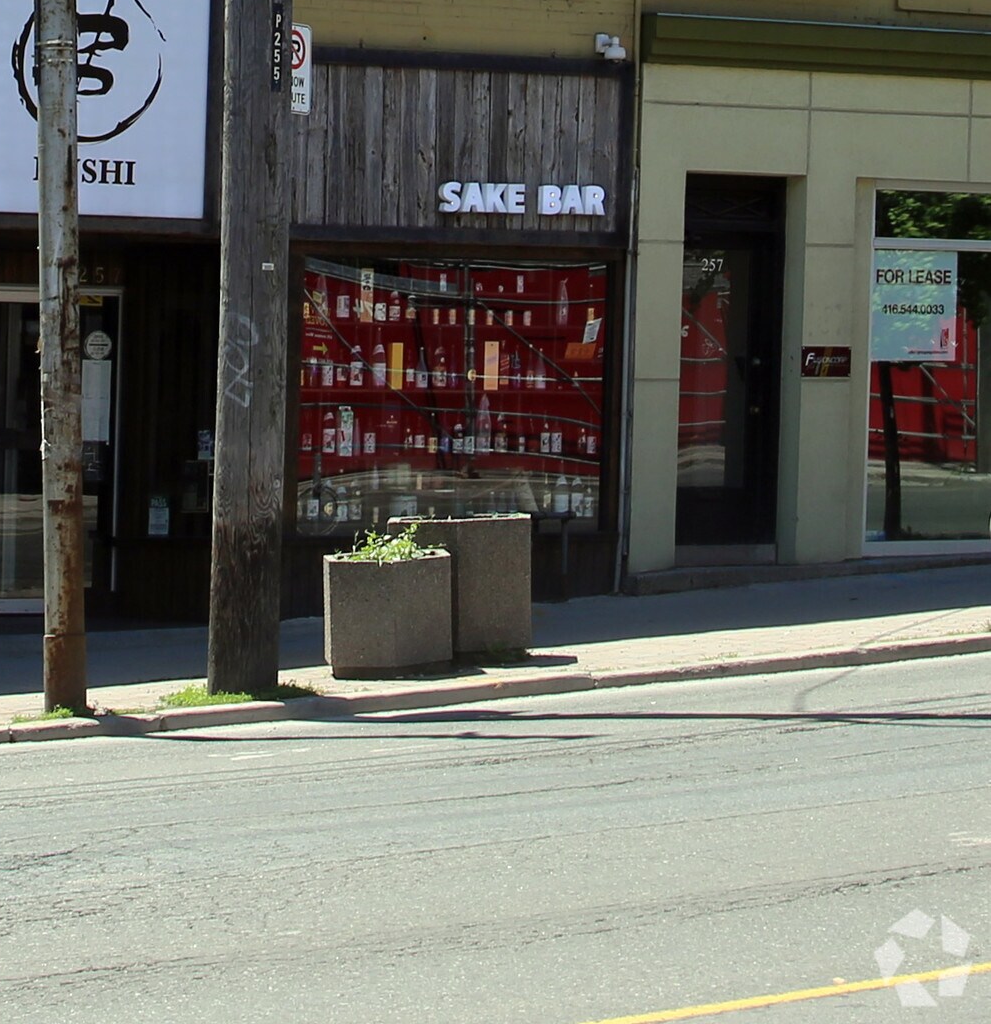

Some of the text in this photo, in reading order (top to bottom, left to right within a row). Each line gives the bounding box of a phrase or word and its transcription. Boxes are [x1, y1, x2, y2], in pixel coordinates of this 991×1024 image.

[273, 14, 282, 80] P255
[438, 181, 605, 216] SAKE BAR
[701, 258, 724, 272] 257
[876, 269, 952, 284] FOR LEASE
[882, 303, 945, 315] 416.544.0033
